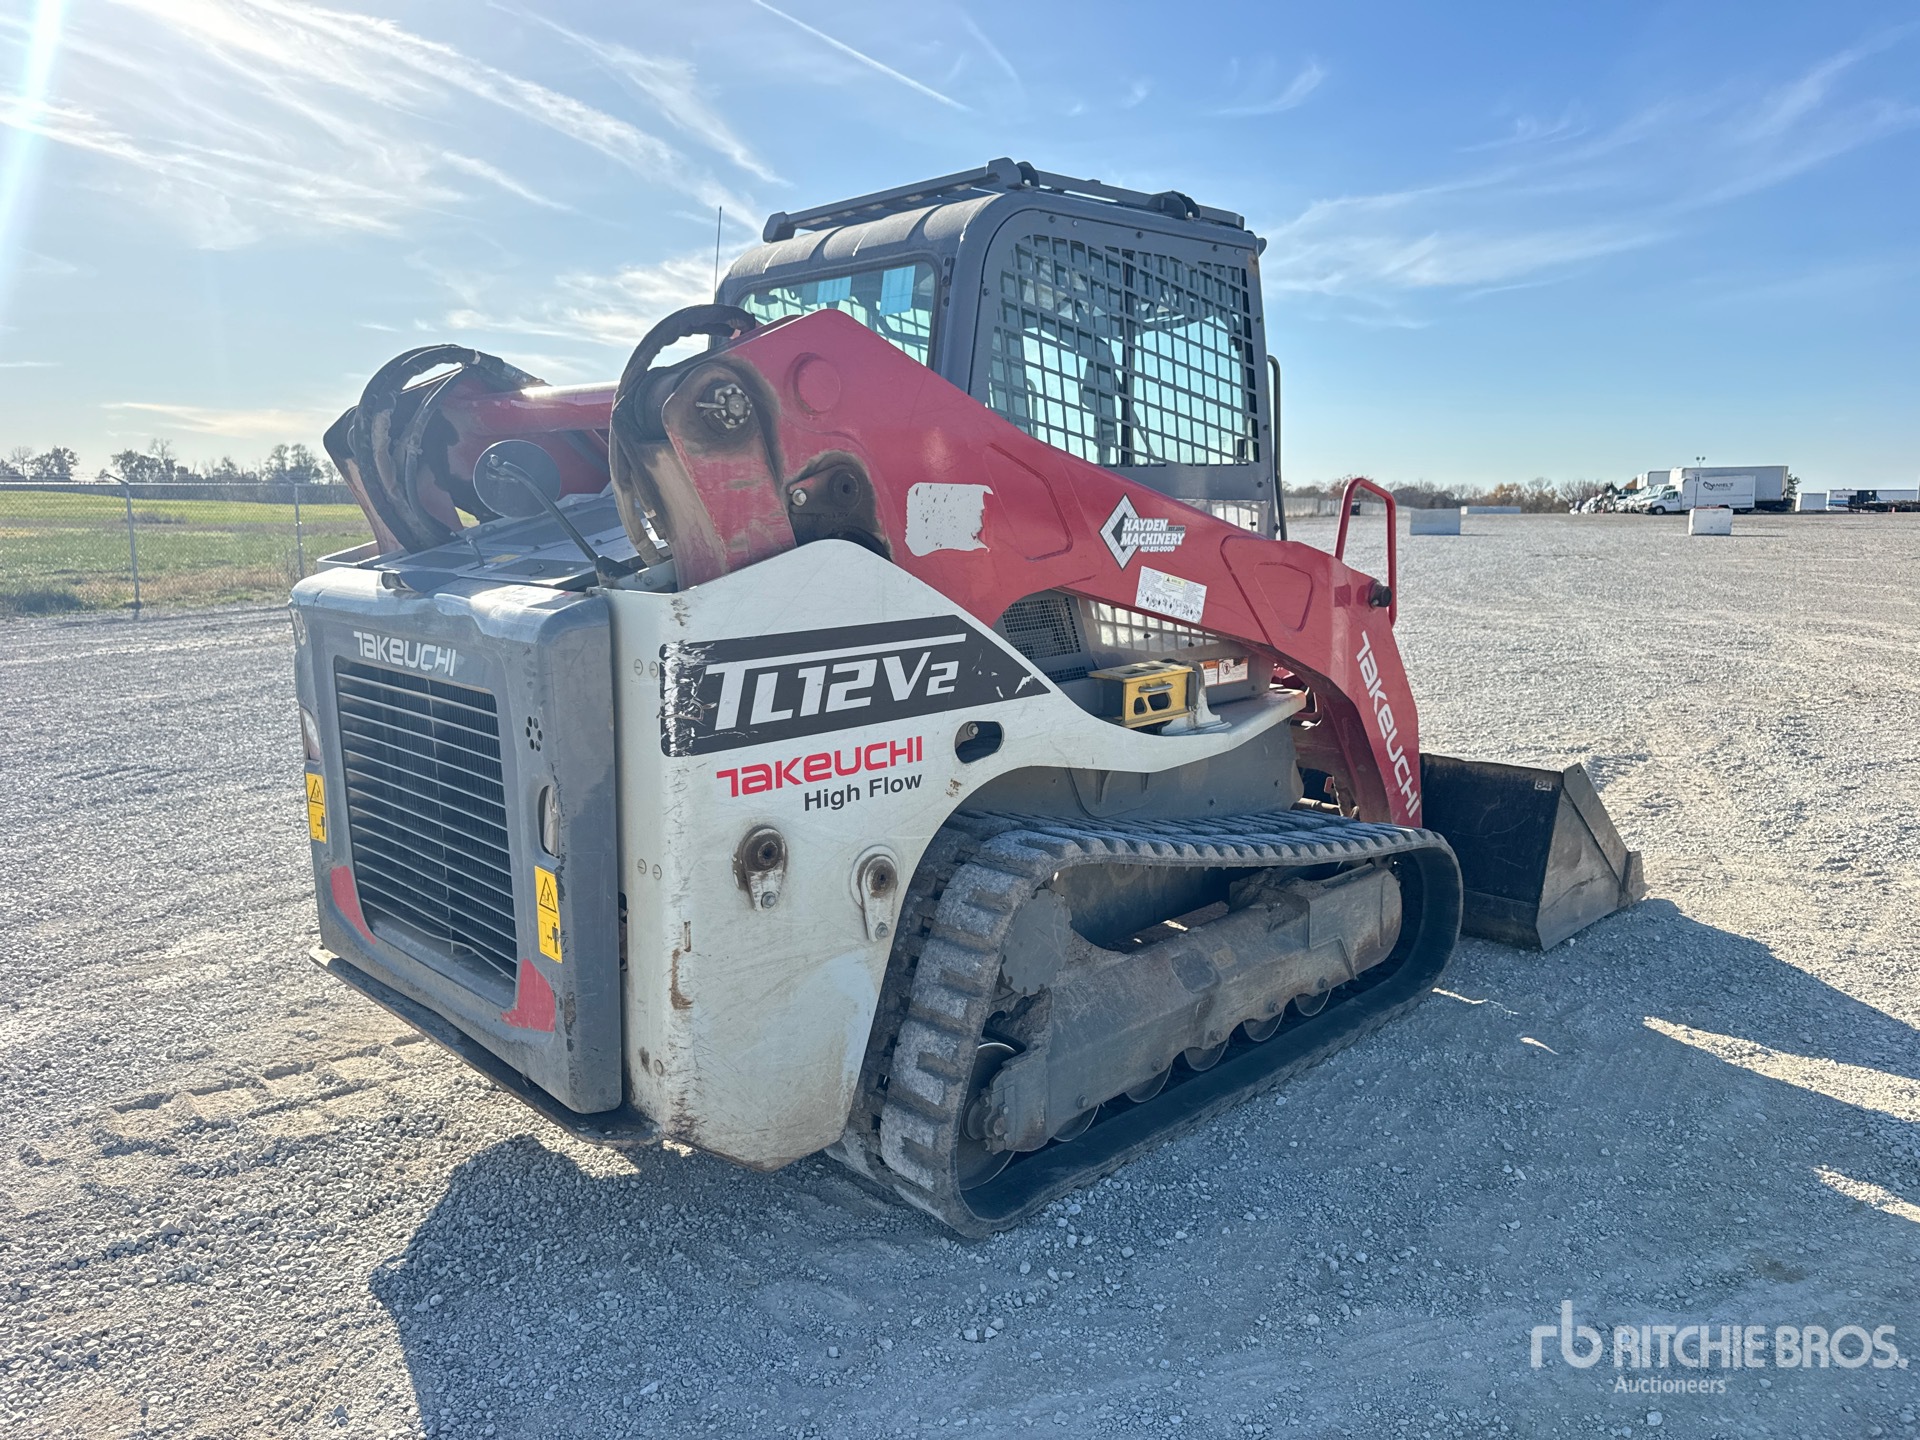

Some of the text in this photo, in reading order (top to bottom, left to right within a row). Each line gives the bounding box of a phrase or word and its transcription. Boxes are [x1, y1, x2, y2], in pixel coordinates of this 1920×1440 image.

[1120, 532, 1186, 545] MACHINERY
[1123, 518, 1168, 531] HAYDEN
[353, 630, 457, 677] TAKEUCHI
[704, 633, 967, 731] TL12V2
[1356, 630, 1420, 818] TAKEUCHI
[716, 735, 923, 797] TAKEUCHI
[804, 773, 922, 811] High Flow
